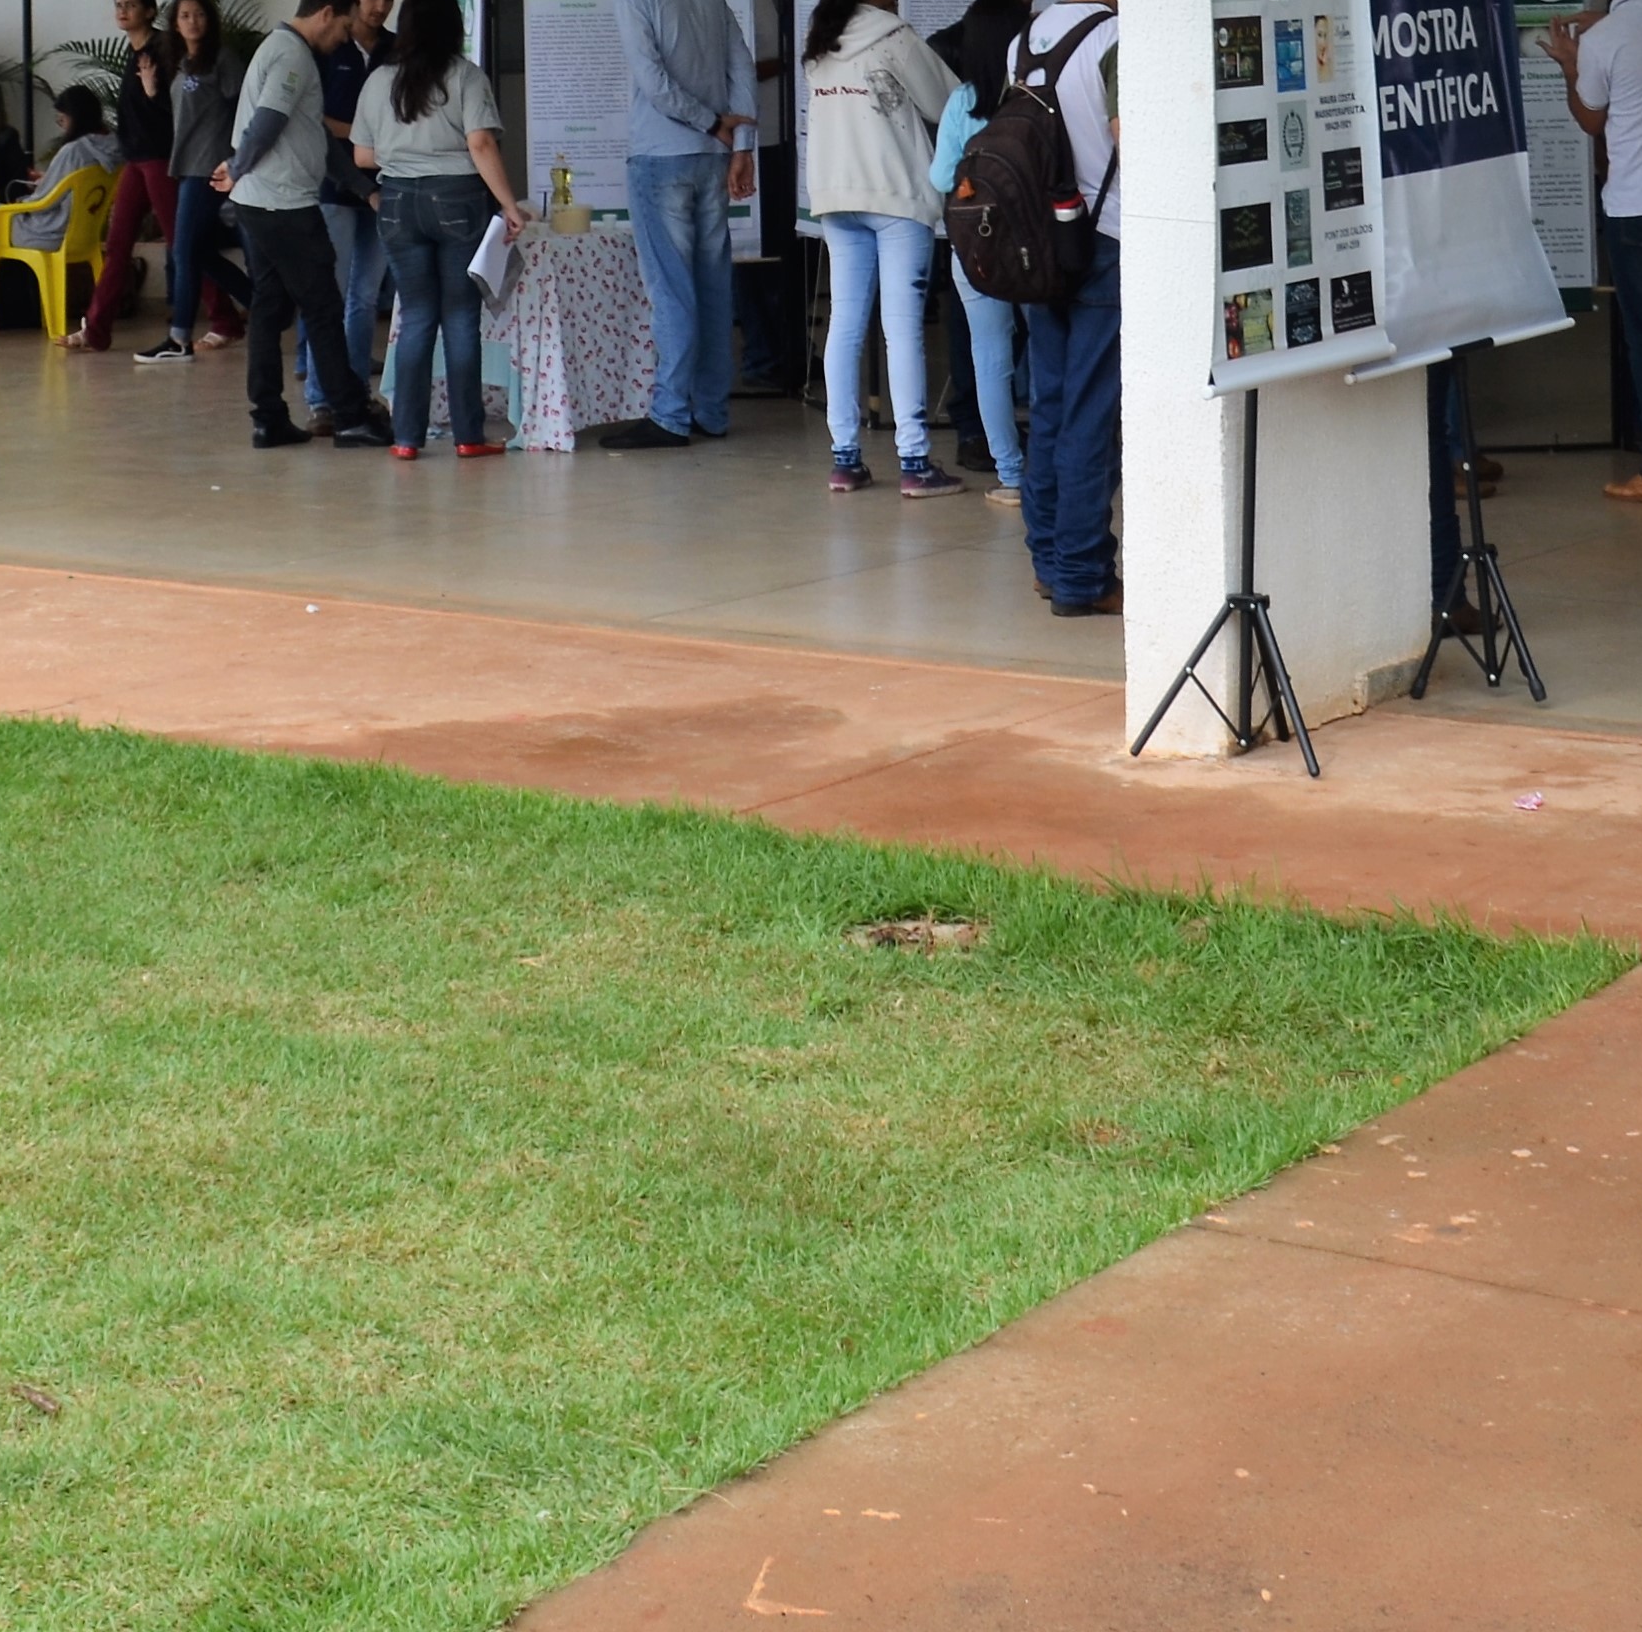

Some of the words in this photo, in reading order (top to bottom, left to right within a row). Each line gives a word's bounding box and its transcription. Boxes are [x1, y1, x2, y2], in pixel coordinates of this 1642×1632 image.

[1372, 6, 1478, 59] MOSTRA
[814, 86, 837, 97] Red
[840, 86, 869, 96] Nose
[1527, 71, 1563, 81] Discussã
[1379, 69, 1499, 132] ENTÍFICA
